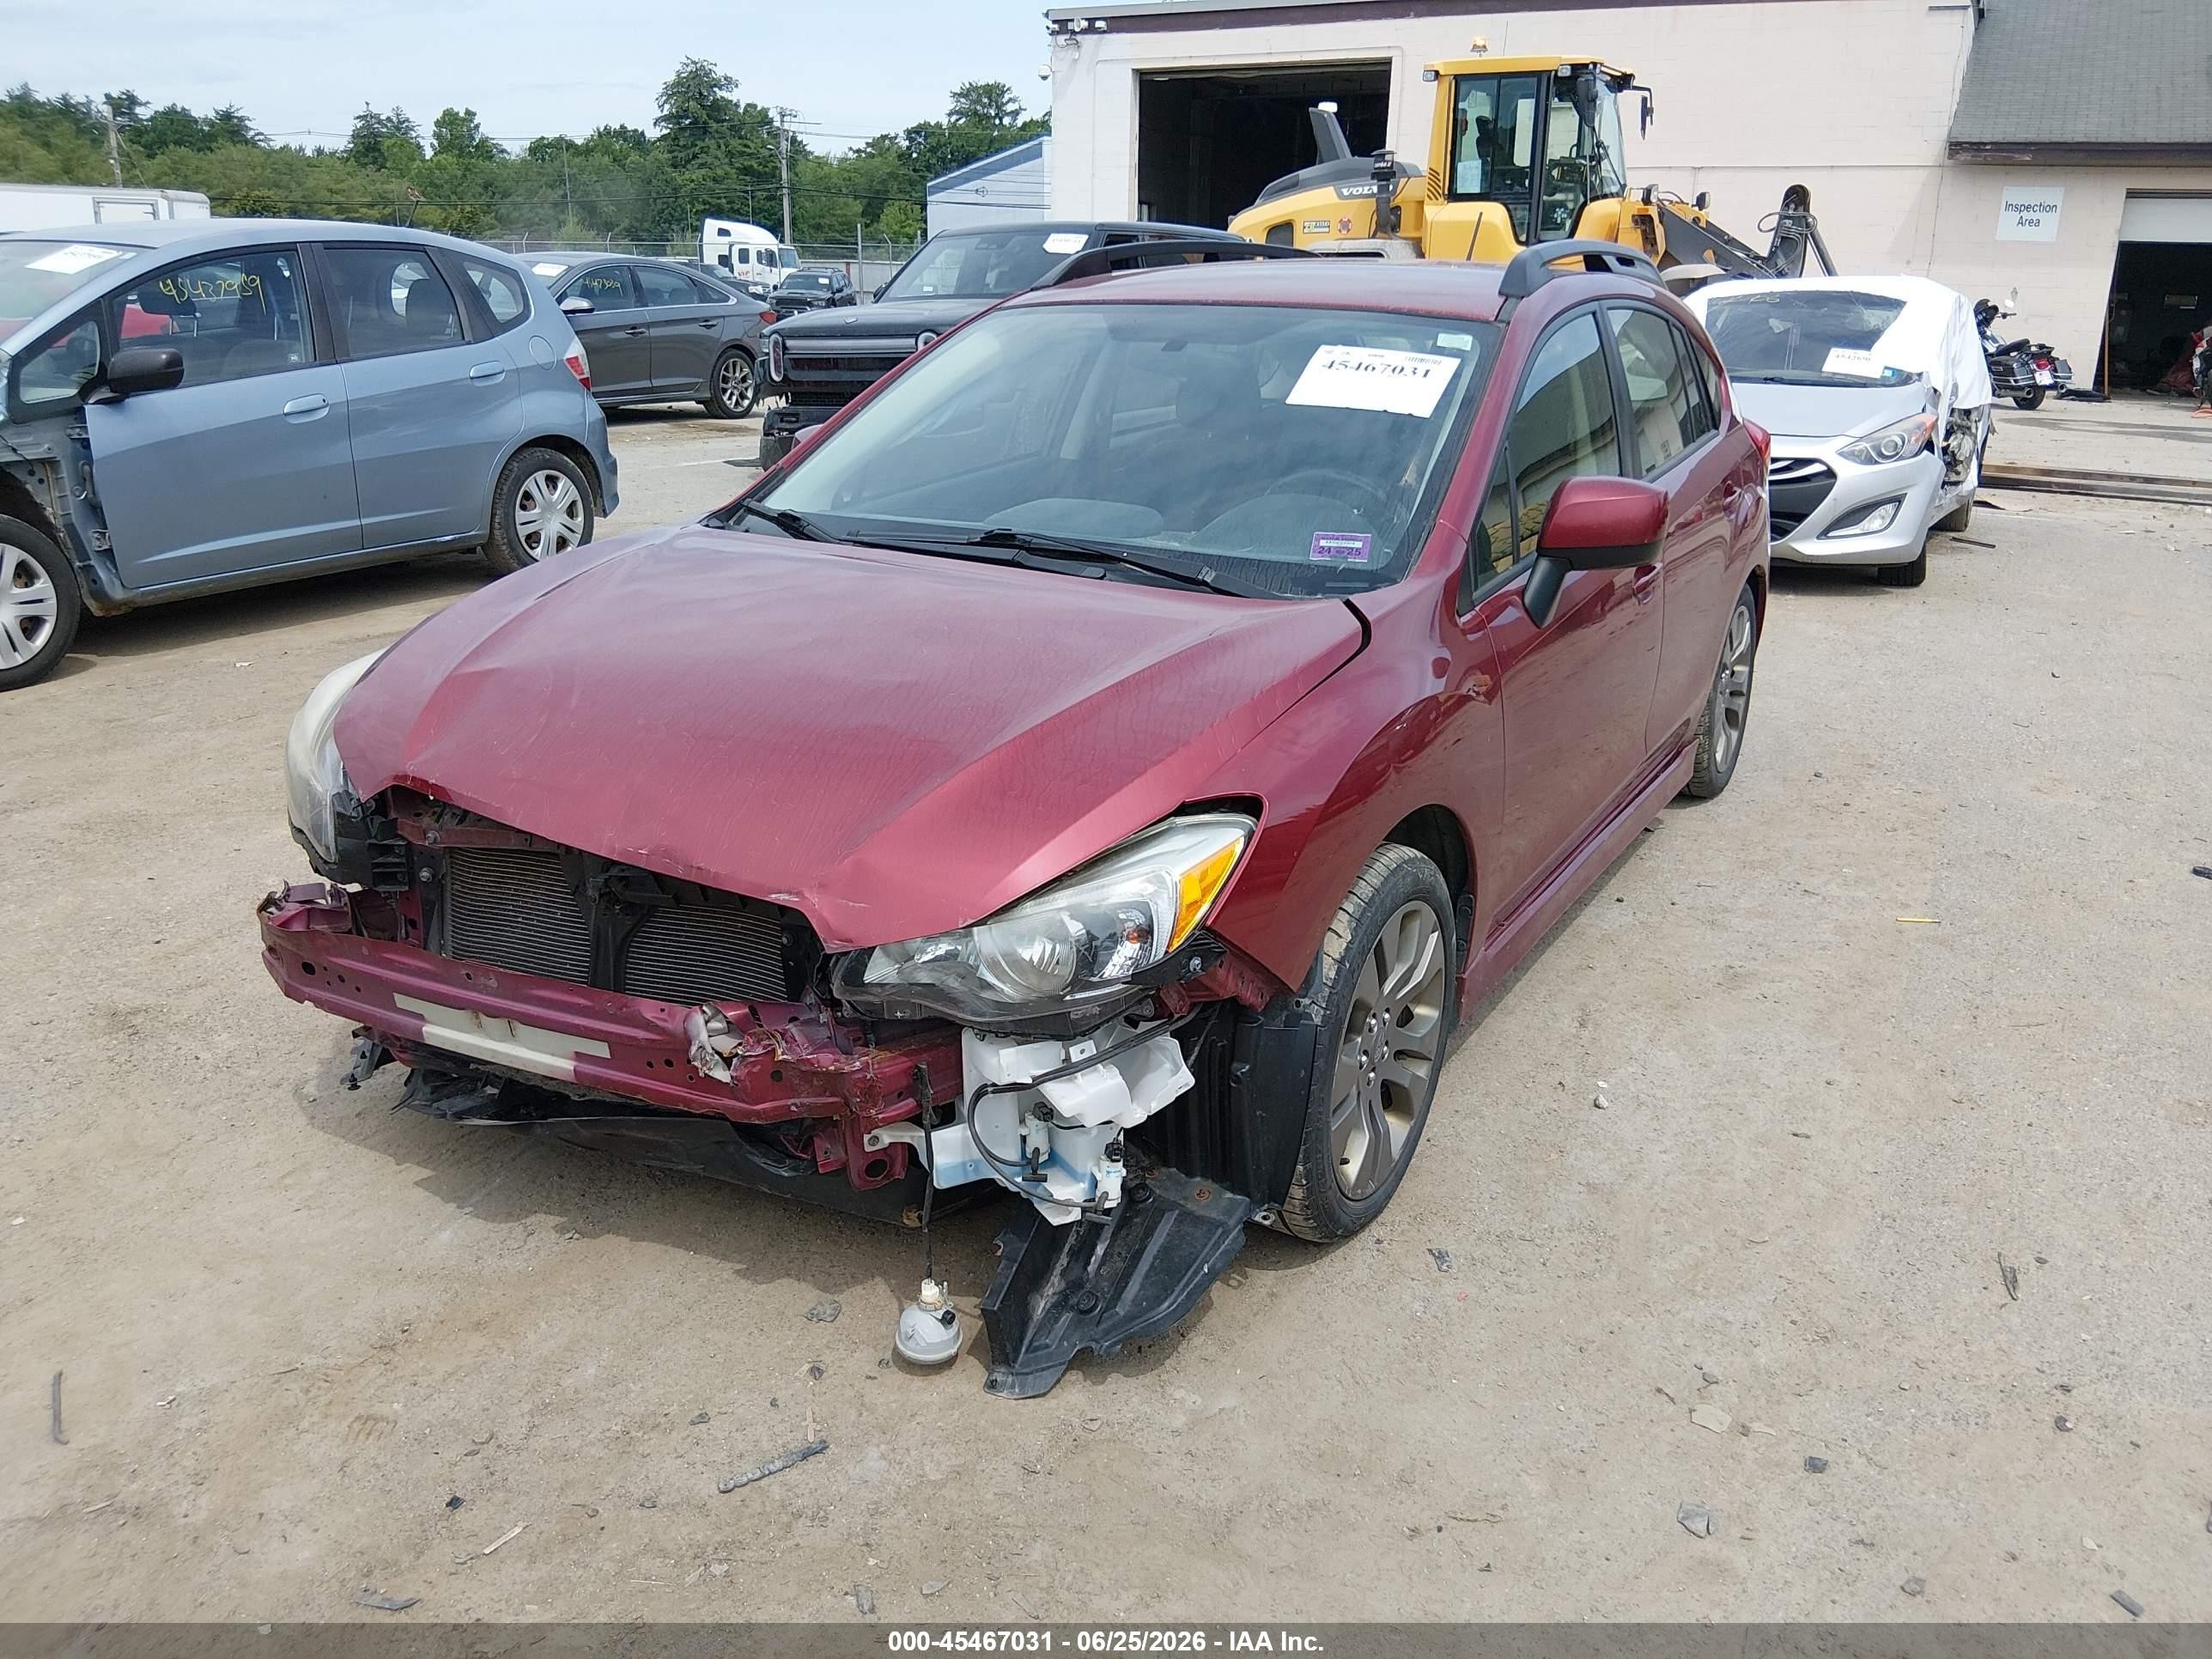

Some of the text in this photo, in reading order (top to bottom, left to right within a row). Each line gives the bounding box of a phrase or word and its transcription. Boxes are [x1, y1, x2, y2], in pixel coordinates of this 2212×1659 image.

[2004, 200, 2057, 216] Inspection
[2016, 215, 2041, 228] Area
[1322, 359, 1431, 380] 45467031
